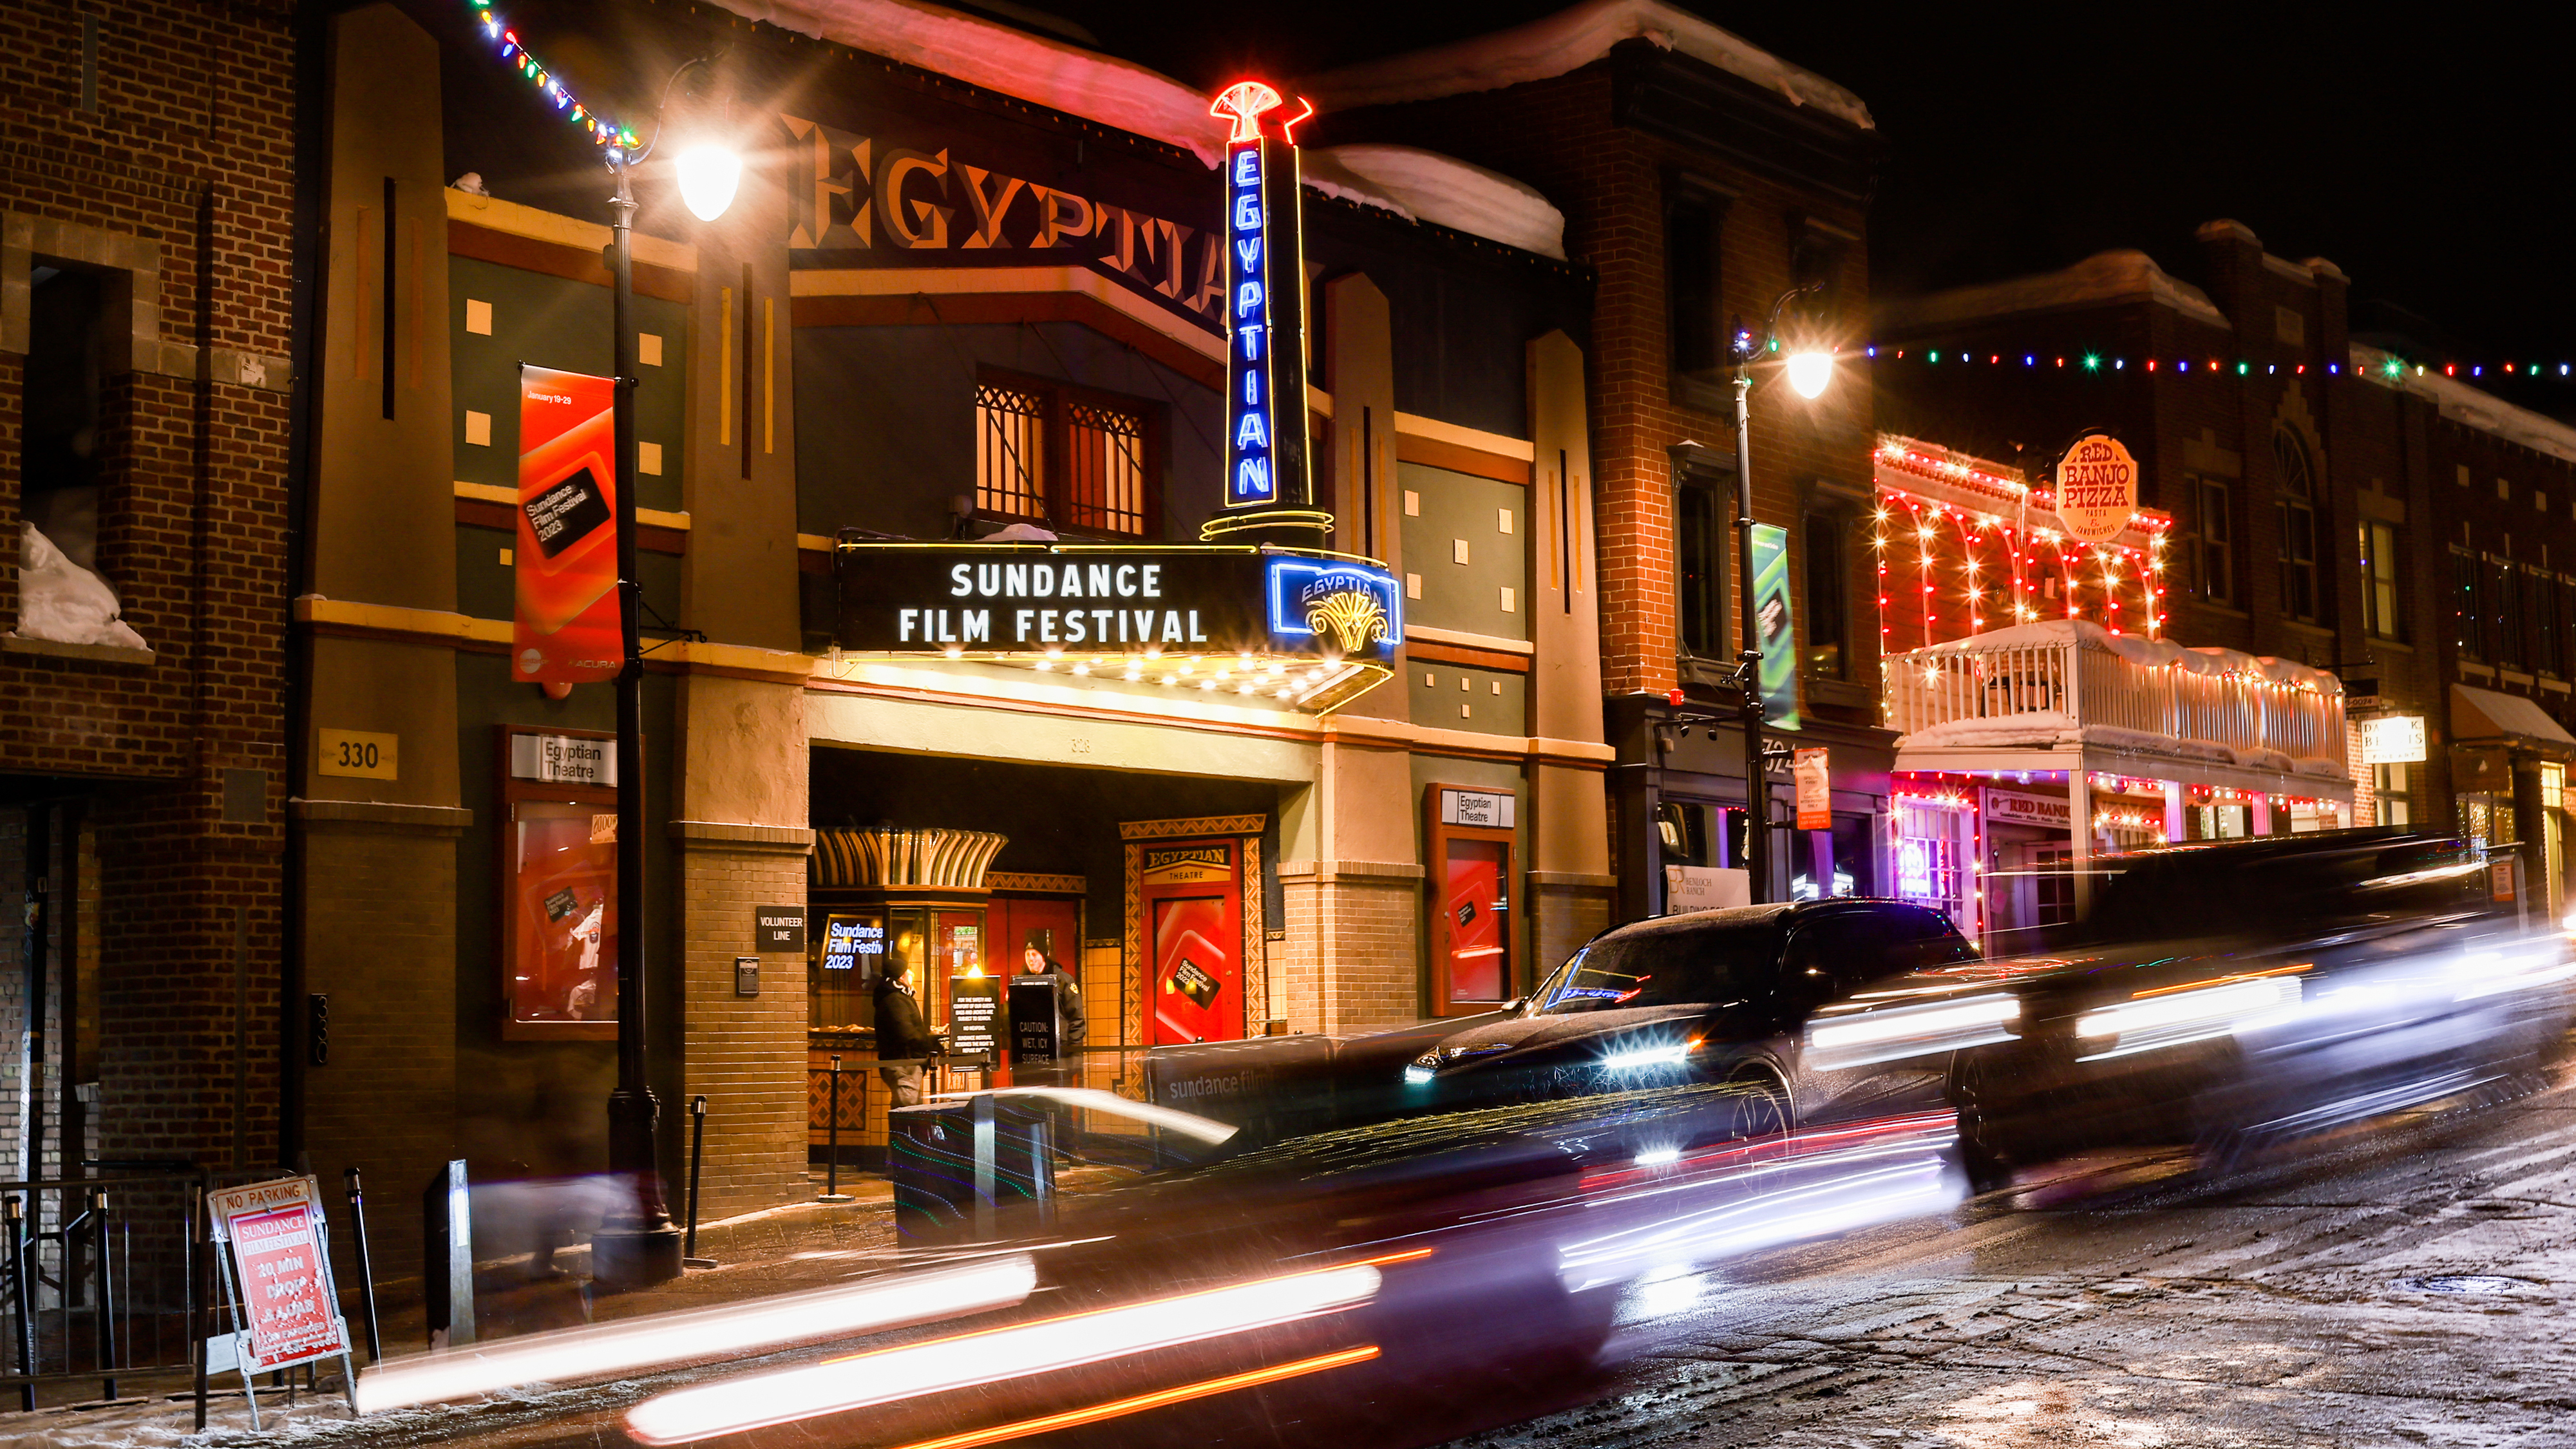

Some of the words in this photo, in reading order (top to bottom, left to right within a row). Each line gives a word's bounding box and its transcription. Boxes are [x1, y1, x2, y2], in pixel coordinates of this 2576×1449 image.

[1236, 150, 1271, 495] EGYPTIAN
[527, 390, 554, 404] January
[554, 394, 572, 405] 19-29
[2079, 442, 2113, 463] RED
[2064, 464, 2130, 486] BANJO
[526, 484, 573, 517] Sundance
[2063, 486, 2129, 509] PIZZA
[531, 508, 554, 530] Film
[553, 488, 588, 520] Festival
[2085, 509, 2107, 517] PASTA
[537, 520, 564, 542] 2023
[2075, 524, 2116, 536] SANDWICHES
[2090, 518, 2099, 527] &
[950, 563, 1162, 598] SUNDANCE
[1301, 575, 1381, 611] EGYPTIAN
[899, 608, 990, 643] FILM
[1016, 609, 1208, 643] FESTIVAL
[575, 659, 616, 668] ACURA
[338, 741, 379, 769] 330
[545, 741, 601, 762] Egyptian
[545, 761, 594, 779] Theatre
[1460, 795, 1492, 810] Egyptian
[2009, 798, 2035, 813] RED
[1460, 810, 1488, 822] Theatre
[1148, 848, 1226, 867] EGYPTIAN
[1170, 871, 1204, 880] THEATRE
[1685, 877, 1712, 887] BENLOCH
[1686, 887, 1705, 896] RANCH
[760, 916, 803, 927] VOLUNTEER
[831, 922, 884, 939] Sundance
[773, 931, 791, 941] LINE
[828, 938, 852, 953] Film
[852, 939, 894, 954] Festivl
[824, 954, 854, 969] 2023
[1178, 966, 1192, 979] Film
[1189, 974, 1210, 992] Festival
[1181, 959, 1208, 983] Sundance
[317, 996, 328, 1063] 330
[1019, 1022, 1048, 1033] CAUTION:
[1022, 1037, 1037, 1049] WET,
[1037, 1038, 1048, 1049] ICY
[1022, 1054, 1050, 1065] SURFACE
[1170, 1075, 1238, 1099] sundance
[226, 1195, 243, 1210] NO
[249, 1184, 301, 1204] PARKING
[242, 1215, 305, 1239] SUNDANCE
[245, 1240, 267, 1255] FILM
[267, 1233, 308, 1248] FESTIVAL
[277, 1256, 305, 1274] MIN
